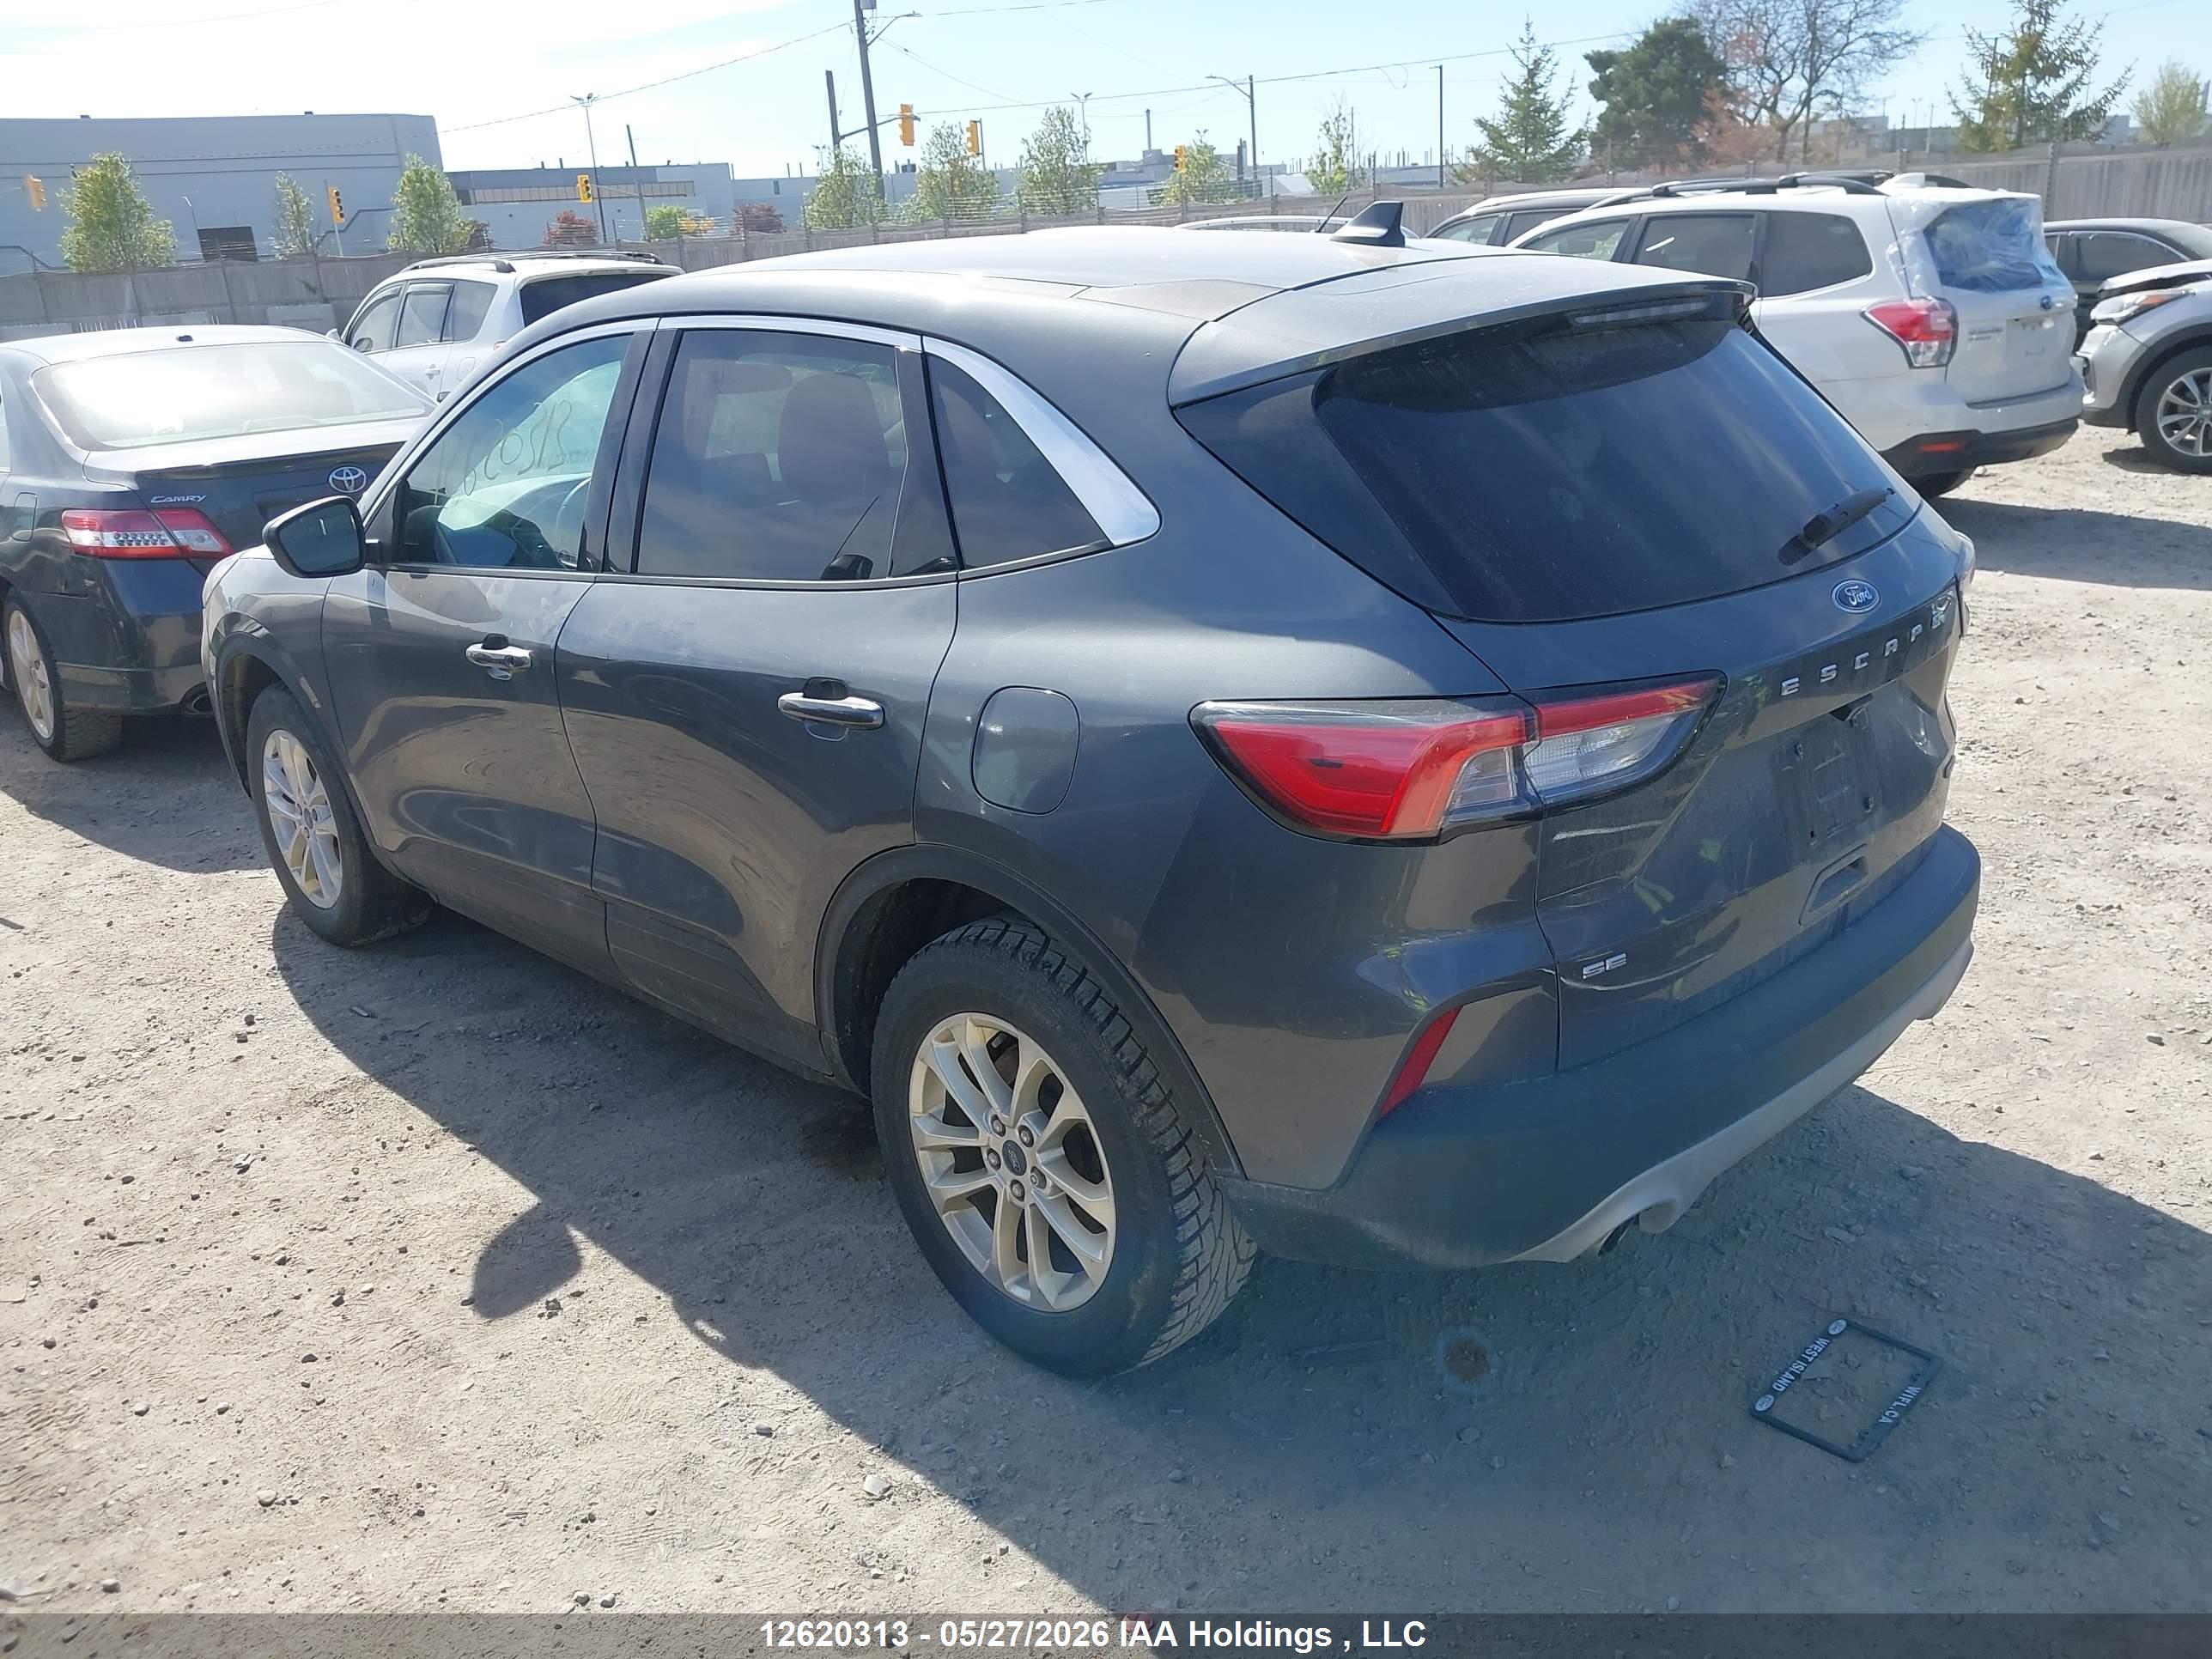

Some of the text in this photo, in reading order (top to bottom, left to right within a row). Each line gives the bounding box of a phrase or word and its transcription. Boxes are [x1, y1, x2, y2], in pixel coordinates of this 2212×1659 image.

[150, 495, 206, 503] CAMRY
[1844, 586, 1873, 606] Ford
[1583, 952, 1627, 979] SE
[1771, 1337, 1831, 1392] WEST ISLAND
